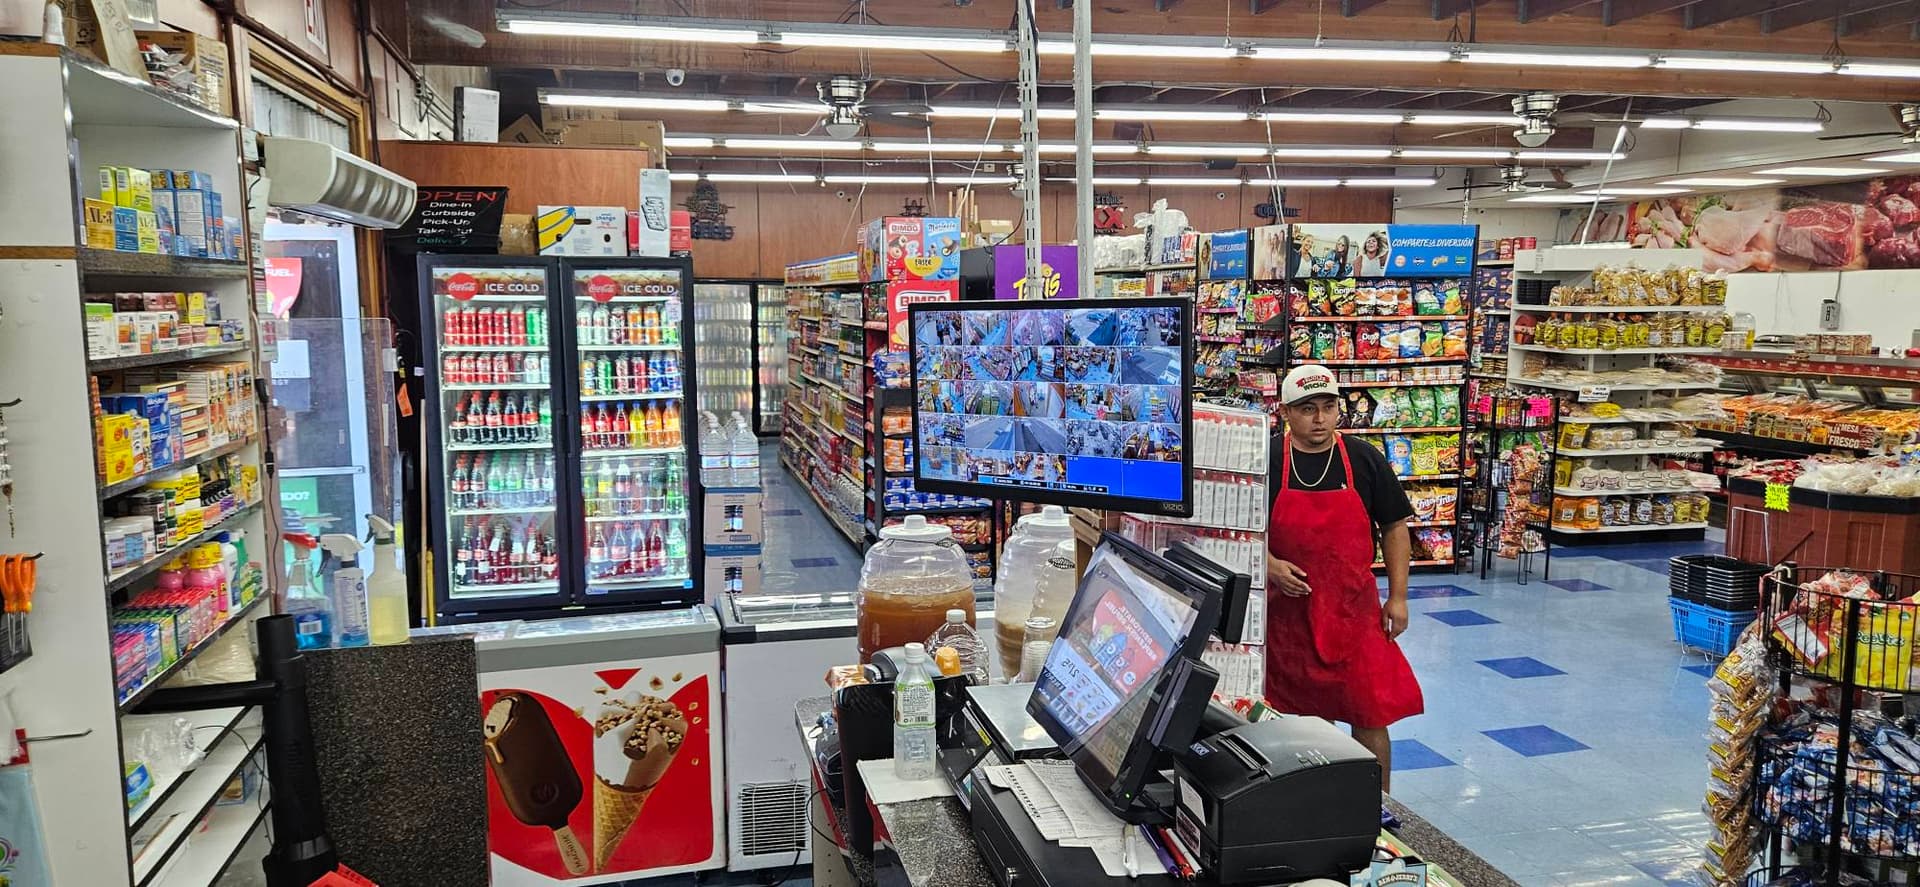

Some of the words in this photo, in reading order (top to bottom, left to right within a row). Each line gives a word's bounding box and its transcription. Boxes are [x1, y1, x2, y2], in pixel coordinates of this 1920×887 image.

[417, 191, 497, 201] OPEN
[891, 224, 918, 232] BIMBO
[416, 237, 468, 245] Delivy
[508, 284, 540, 292] COLD
[623, 285, 641, 293] ICE
[645, 285, 675, 293] COLD
[1828, 435, 1859, 449] FRESCO
